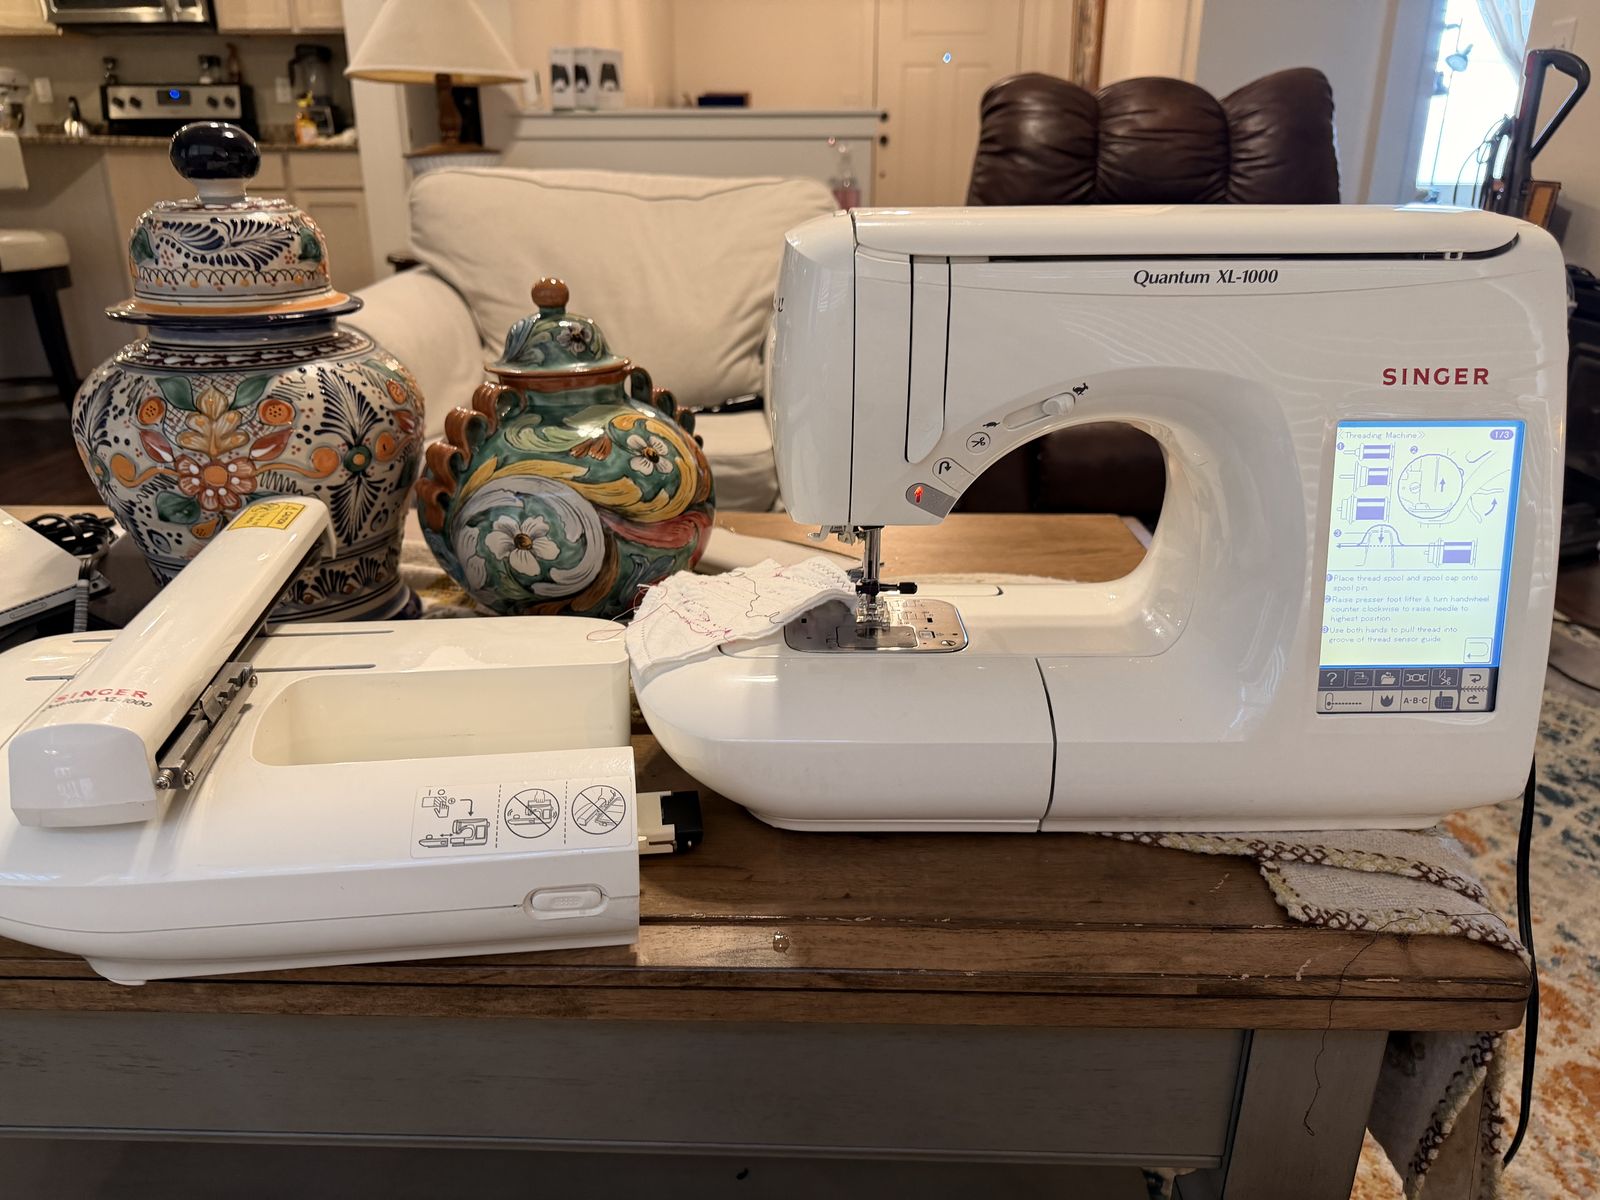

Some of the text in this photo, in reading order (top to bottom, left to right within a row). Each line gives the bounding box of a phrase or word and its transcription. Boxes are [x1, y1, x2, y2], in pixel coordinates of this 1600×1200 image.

[1133, 269, 1279, 288] Quantum XL-1000
[1382, 367, 1490, 386] SINGER
[1492, 430, 1511, 440] 1/3
[1333, 574, 1354, 582] Place
[1357, 574, 1381, 582] thread
[1383, 574, 1404, 583] spool
[1332, 595, 1353, 603] Raise
[1387, 595, 1402, 603] foot
[1330, 615, 1358, 623] highest
[1400, 626, 1415, 634] pull
[54, 687, 149, 703] SINGER
